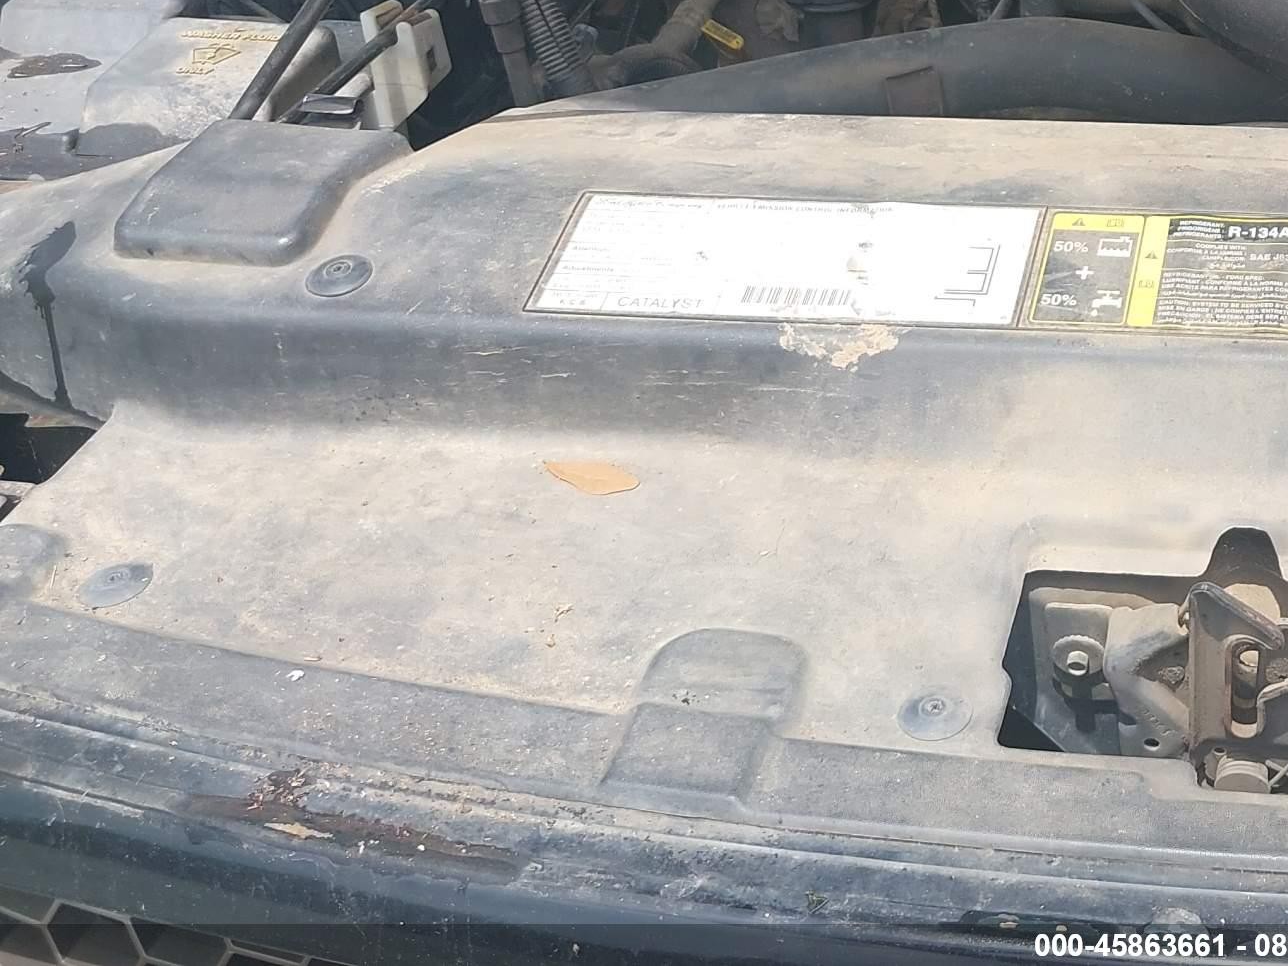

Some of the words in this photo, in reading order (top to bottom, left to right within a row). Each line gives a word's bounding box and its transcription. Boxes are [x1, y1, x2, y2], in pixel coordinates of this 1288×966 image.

[1054, 240, 1089, 254] 50%
[1249, 253, 1272, 261] SAE
[617, 295, 705, 309] CATALYST
[1040, 293, 1077, 307] 50%
